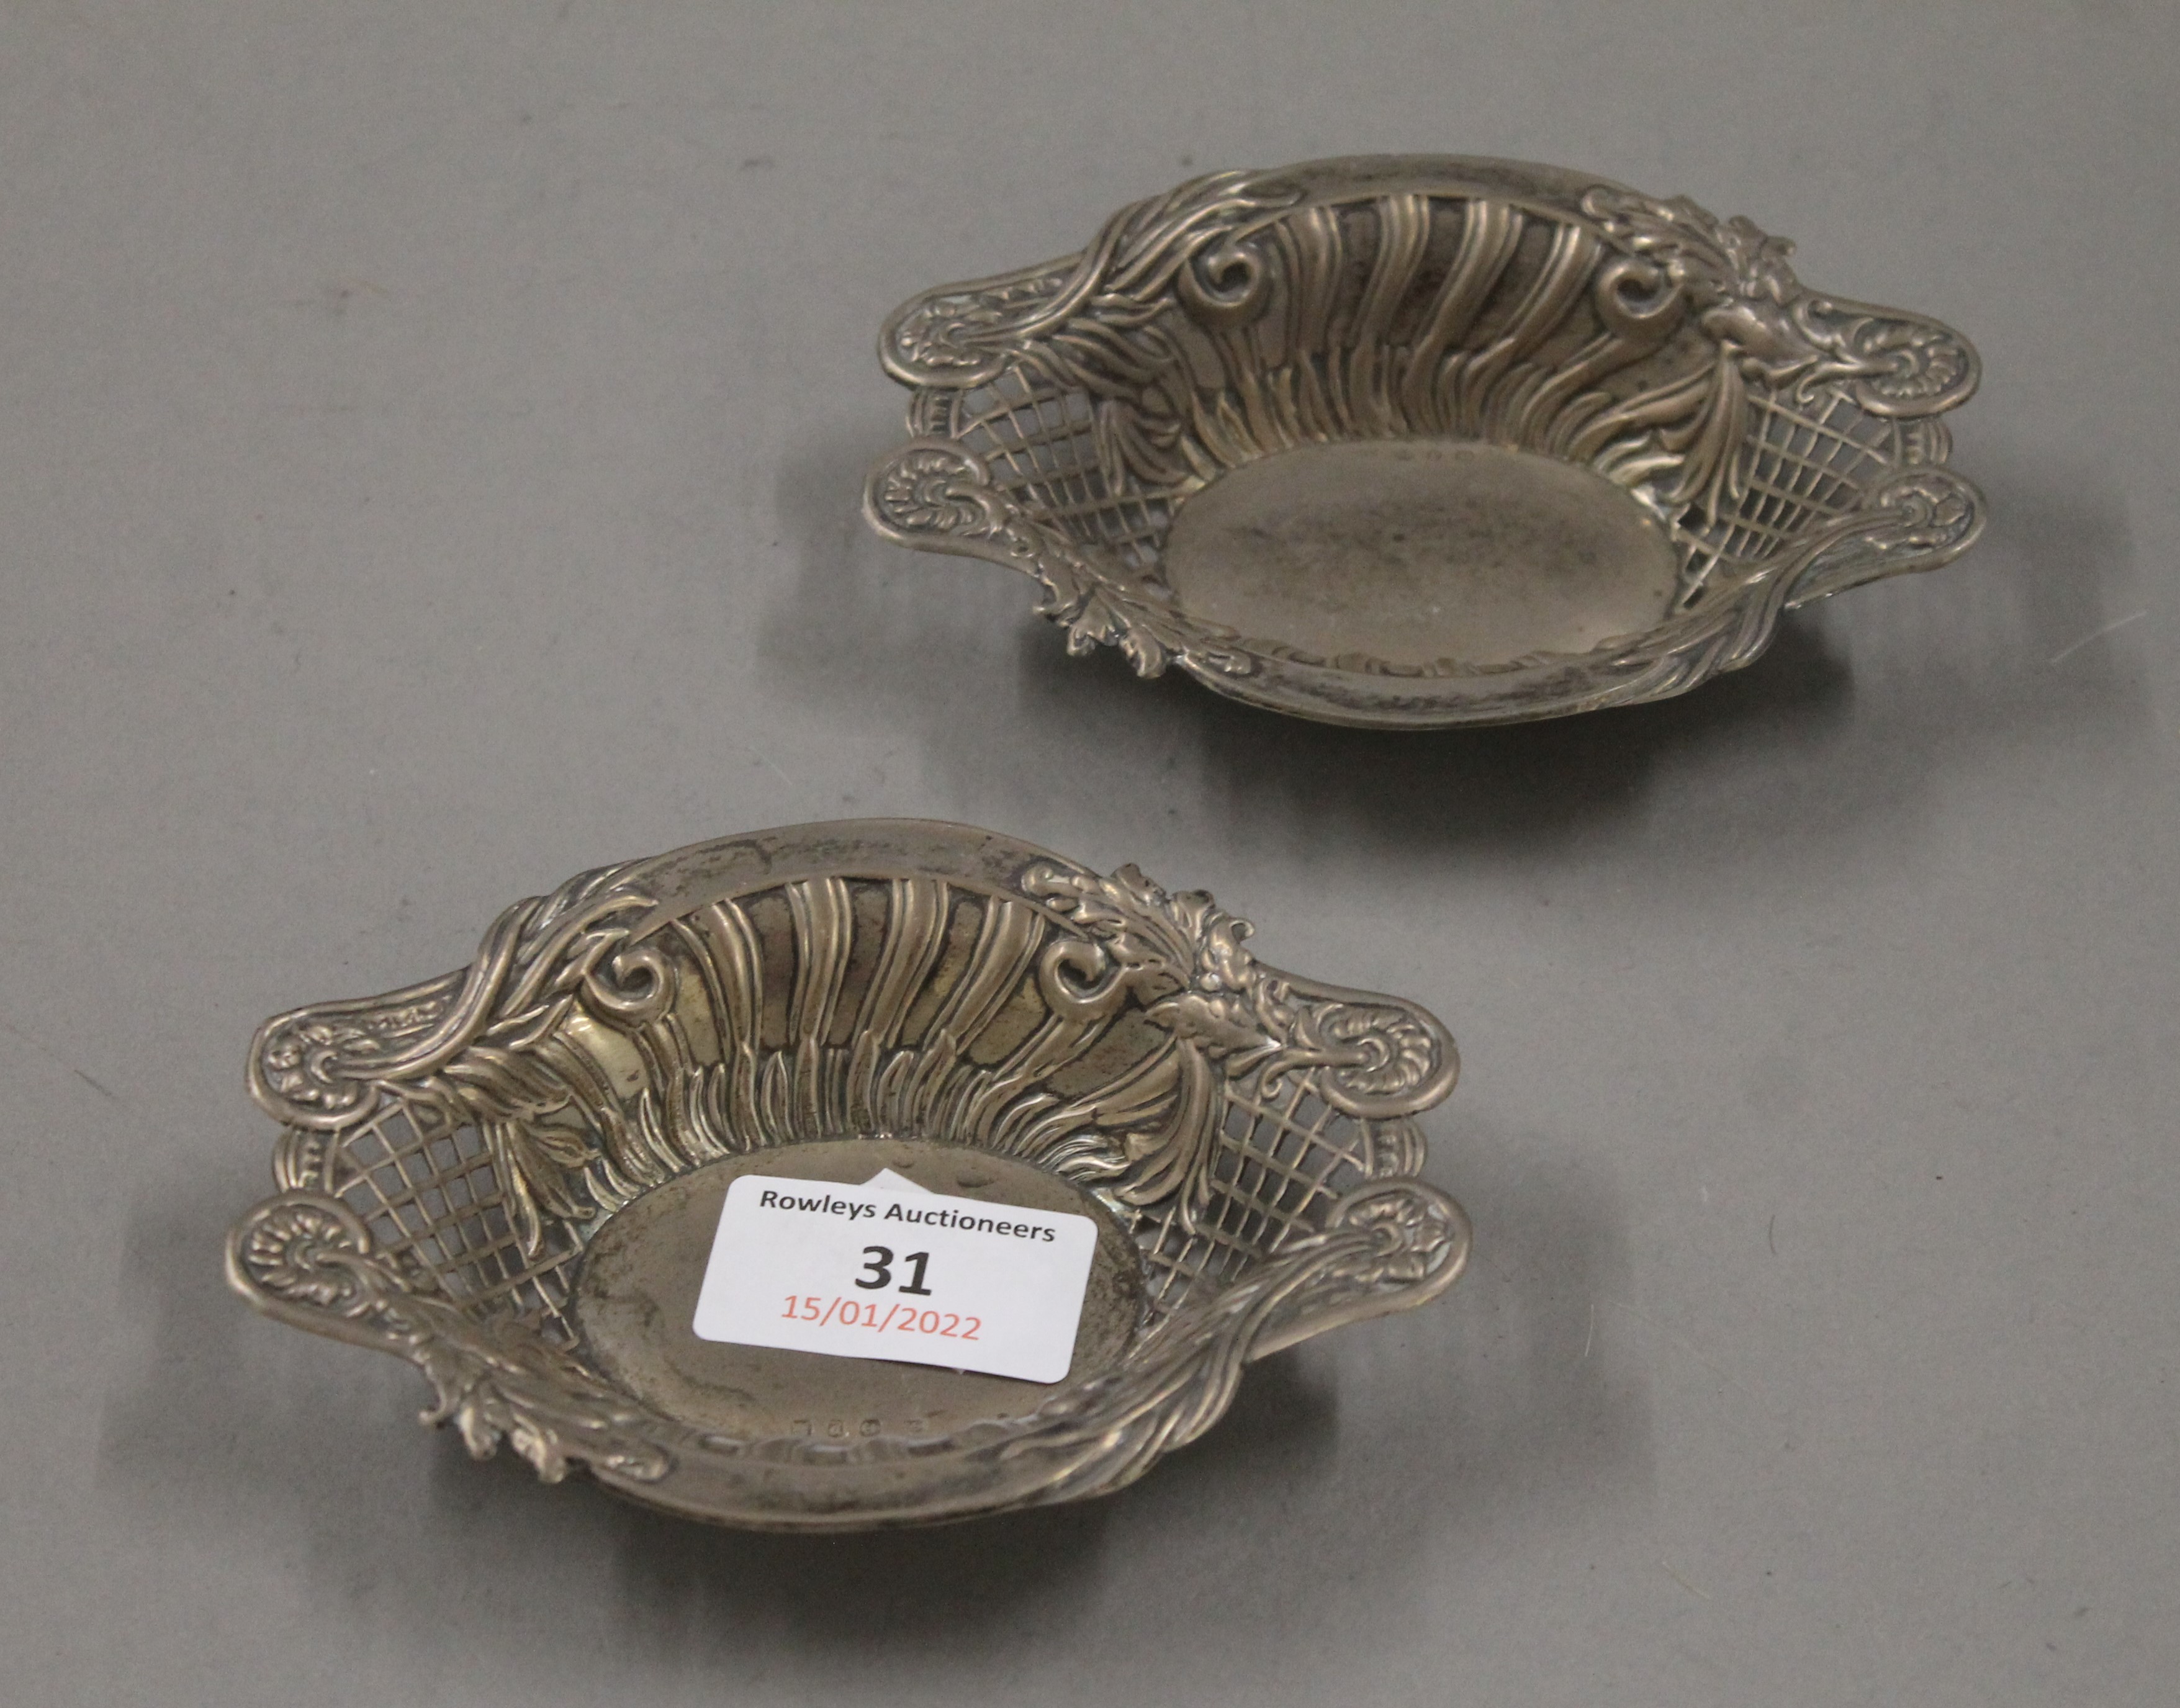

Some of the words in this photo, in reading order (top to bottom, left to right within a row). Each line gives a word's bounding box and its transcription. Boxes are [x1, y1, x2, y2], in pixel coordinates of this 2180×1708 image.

[759, 1190, 876, 1221] Rowleys
[883, 1203, 1056, 1243] Auctioneers
[854, 1245, 932, 1297] 31
[781, 1295, 981, 1341] 15/01/2022
